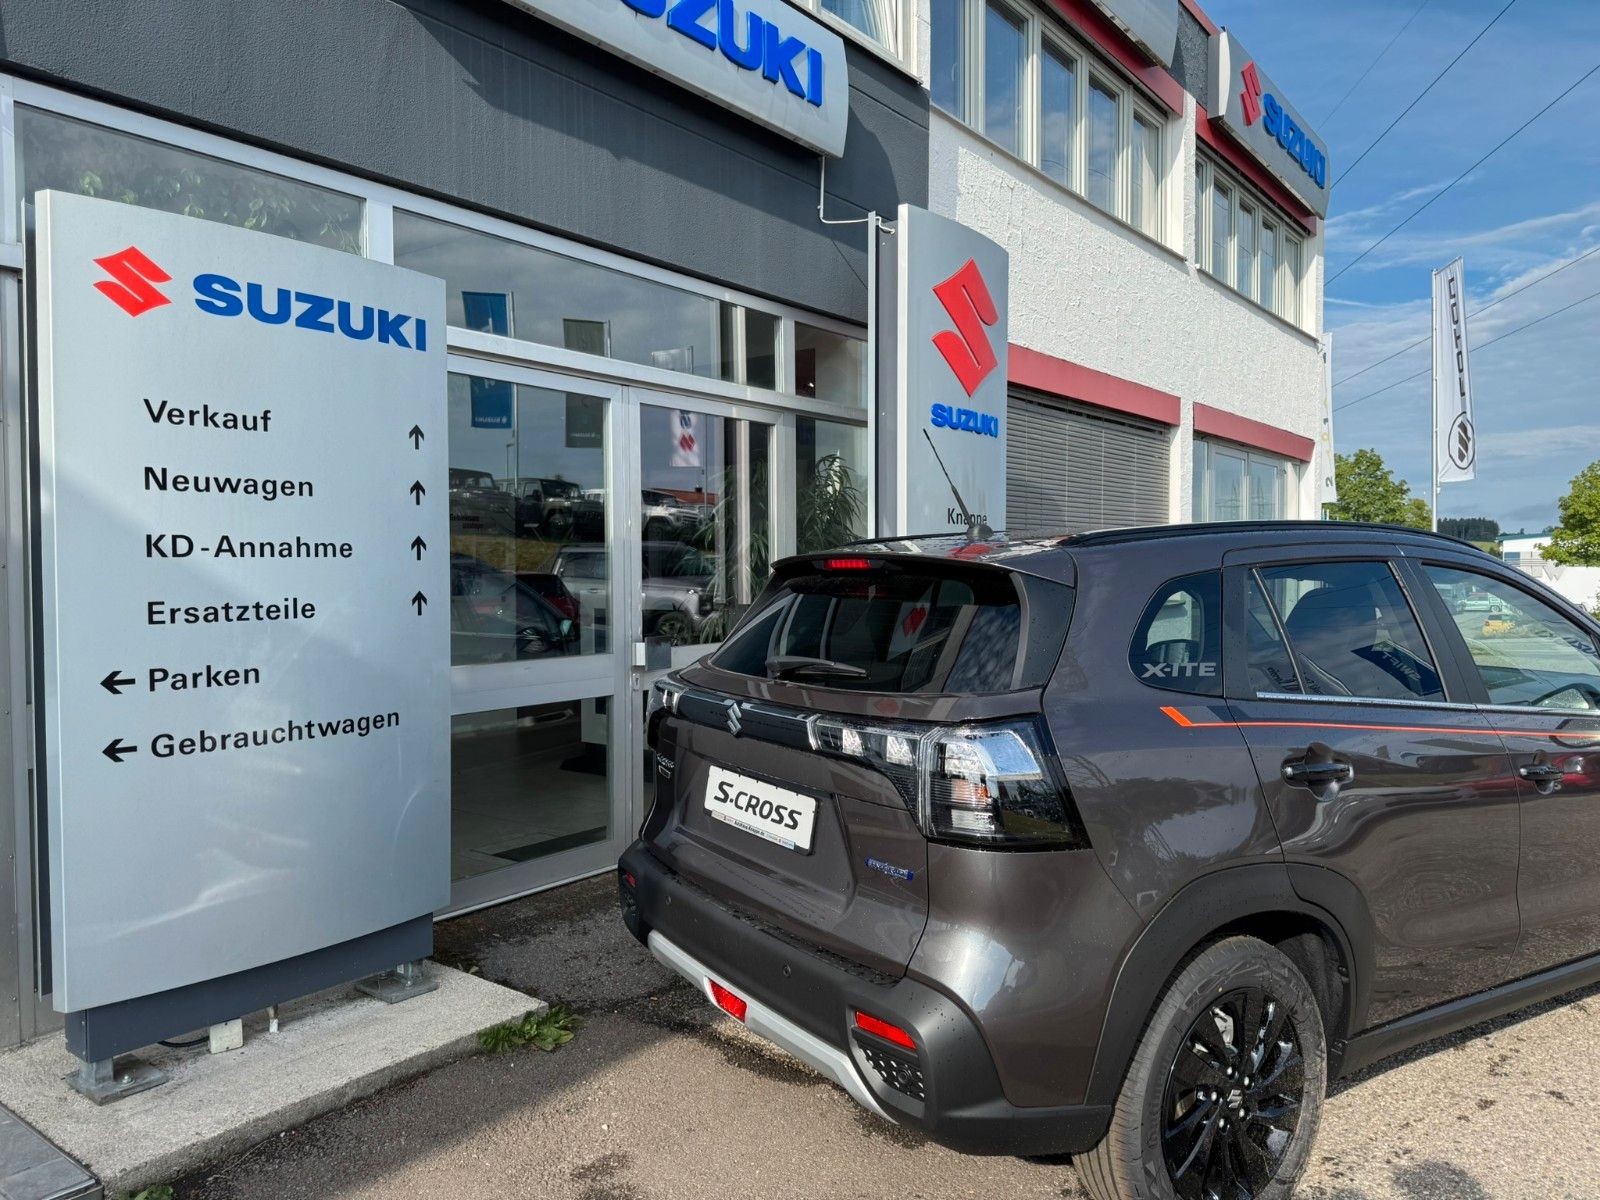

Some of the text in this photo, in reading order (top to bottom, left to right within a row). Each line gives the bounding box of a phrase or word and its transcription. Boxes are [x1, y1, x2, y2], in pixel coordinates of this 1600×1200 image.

[620, 0, 823, 107] ZUKI
[1263, 93, 1326, 189] SUZUKI
[193, 273, 427, 352] SUZUKI
[143, 399, 272, 432] Verkauf
[931, 403, 998, 438] SUZUKI
[144, 467, 314, 500] Neuwagen
[147, 598, 316, 625] Ersatzteile
[149, 665, 260, 692] Parken
[1141, 662, 1217, 678] X-ITE
[151, 711, 400, 758] Gebrauchtwagen
